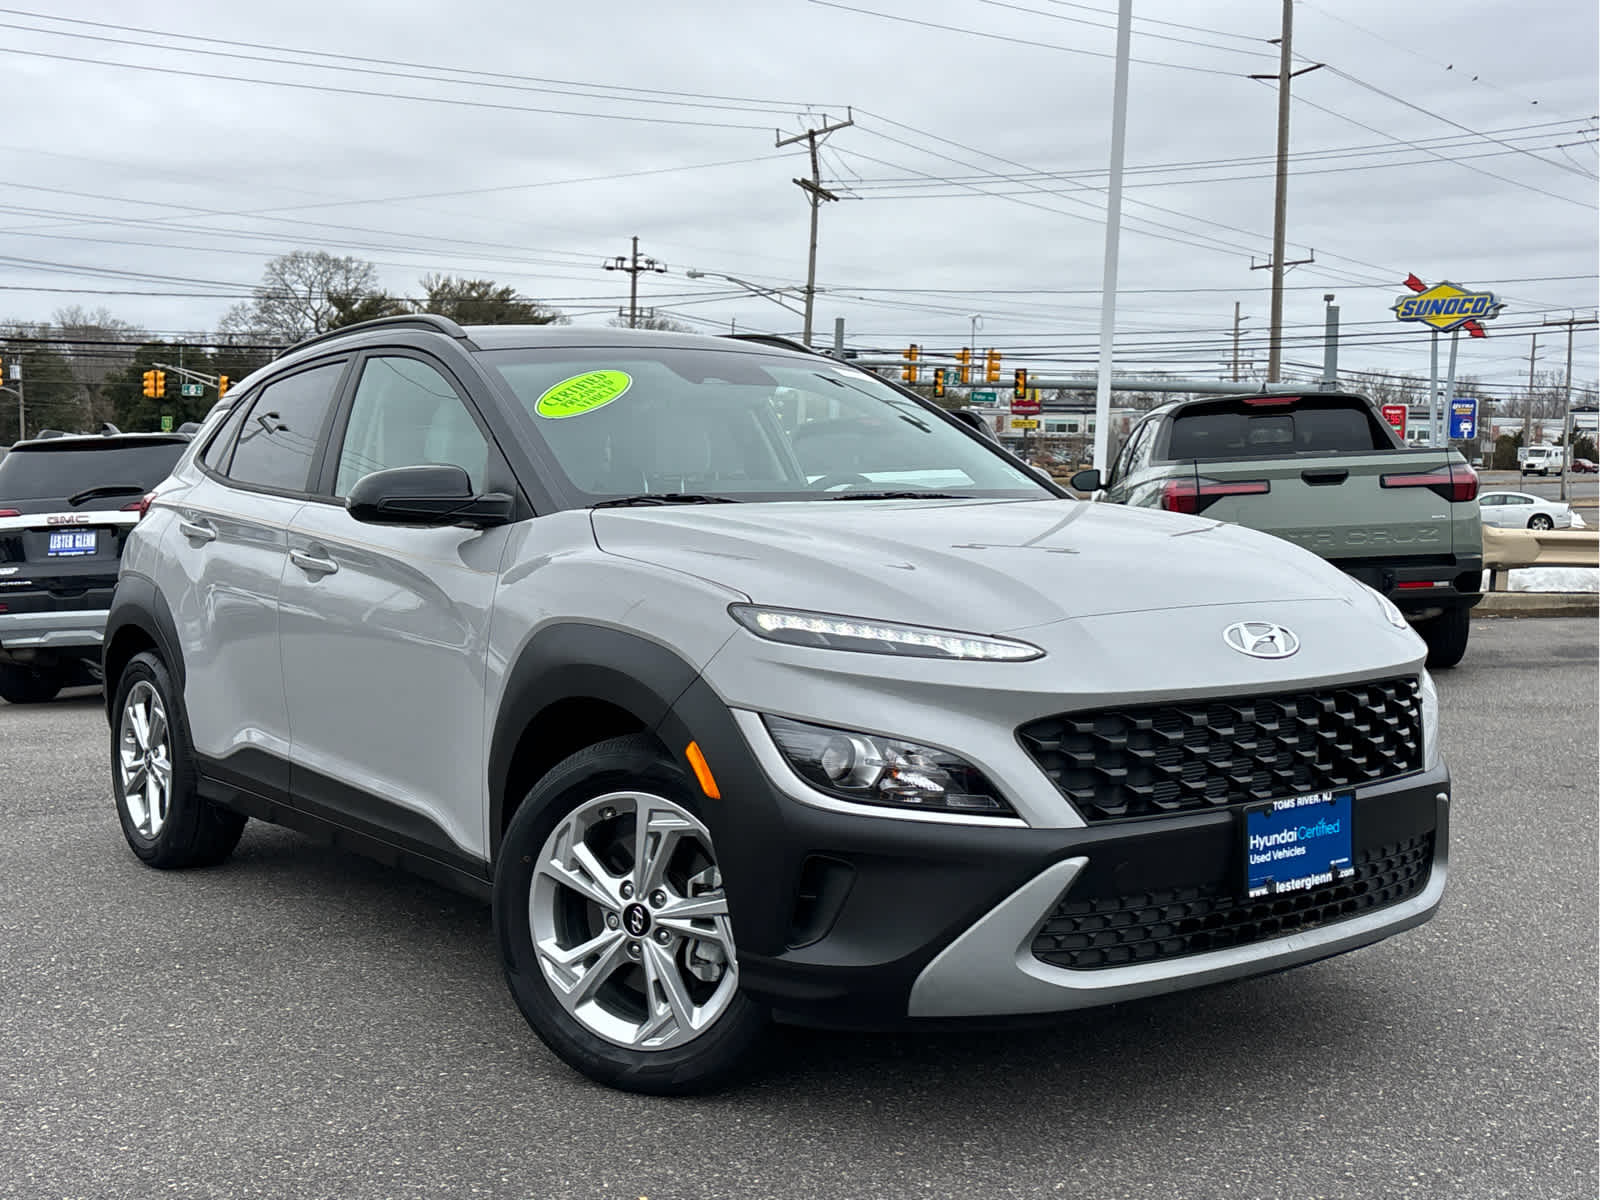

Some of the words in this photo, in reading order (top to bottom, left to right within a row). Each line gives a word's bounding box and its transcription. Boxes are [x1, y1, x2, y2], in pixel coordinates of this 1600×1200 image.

[1400, 297, 1488, 316] SUNOCO
[543, 374, 607, 406] CERTIFIED
[47, 515, 89, 524] GMC
[49, 534, 74, 549] LESTER
[1273, 799, 1295, 811] TOMS
[1322, 791, 1332, 801] NJ
[1250, 852, 1271, 865] Used
[1272, 846, 1306, 861] Vehicles
[1276, 872, 1333, 894] lesterglenn
